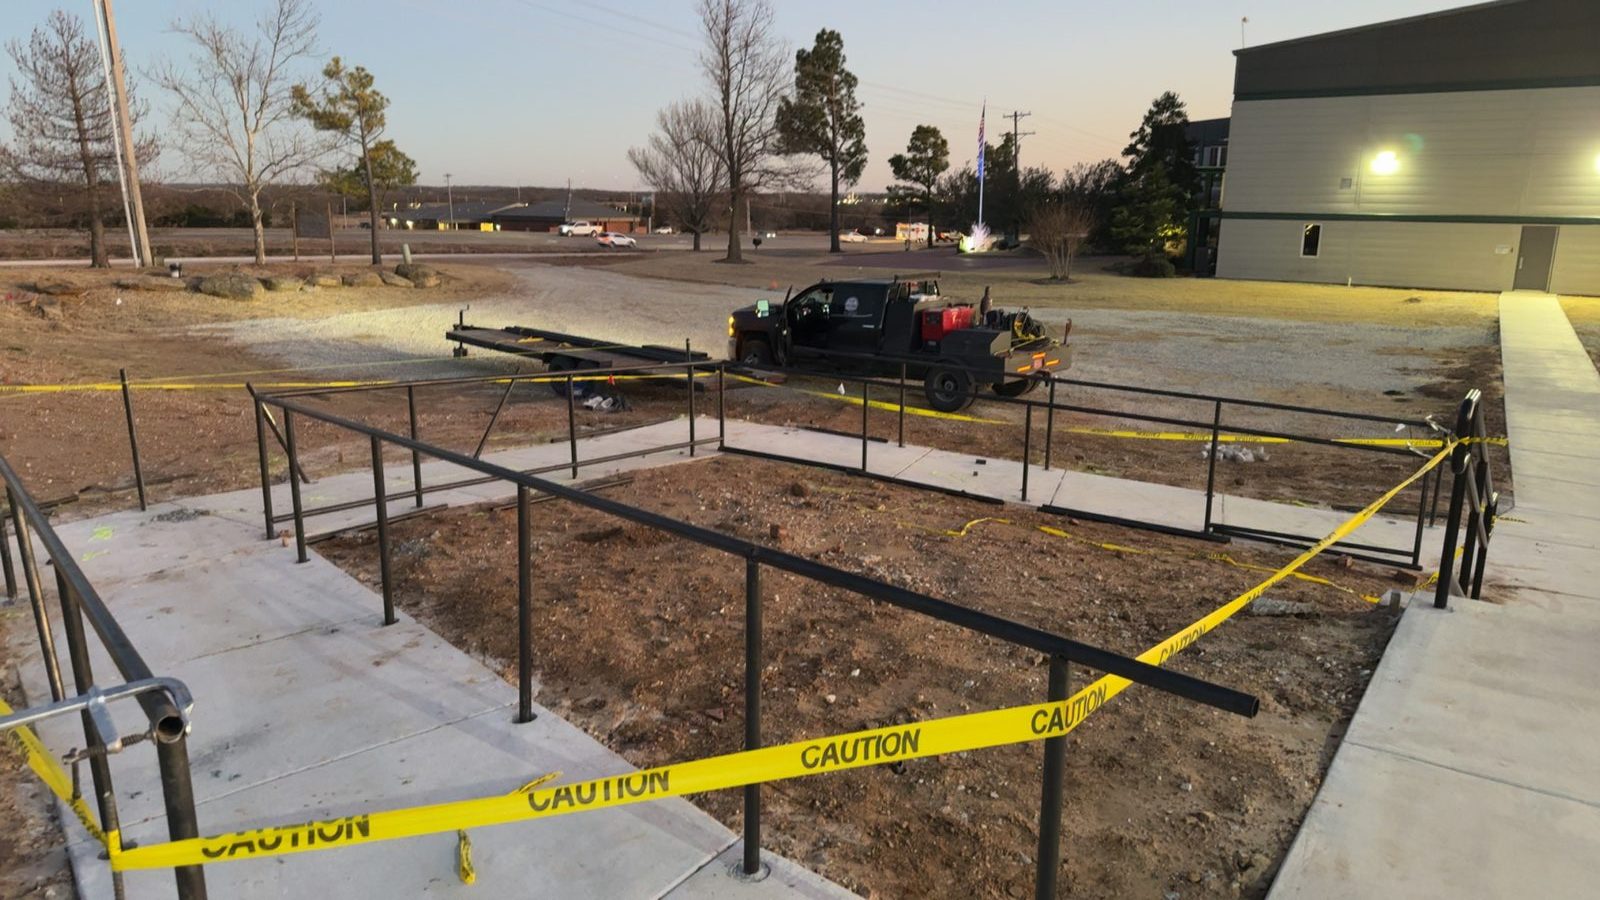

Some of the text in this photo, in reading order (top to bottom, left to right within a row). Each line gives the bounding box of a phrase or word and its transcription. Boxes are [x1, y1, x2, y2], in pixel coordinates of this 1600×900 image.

[1031, 682, 1107, 734] CAUTION
[801, 728, 921, 769] CAUTION
[528, 770, 671, 812] CAUTION
